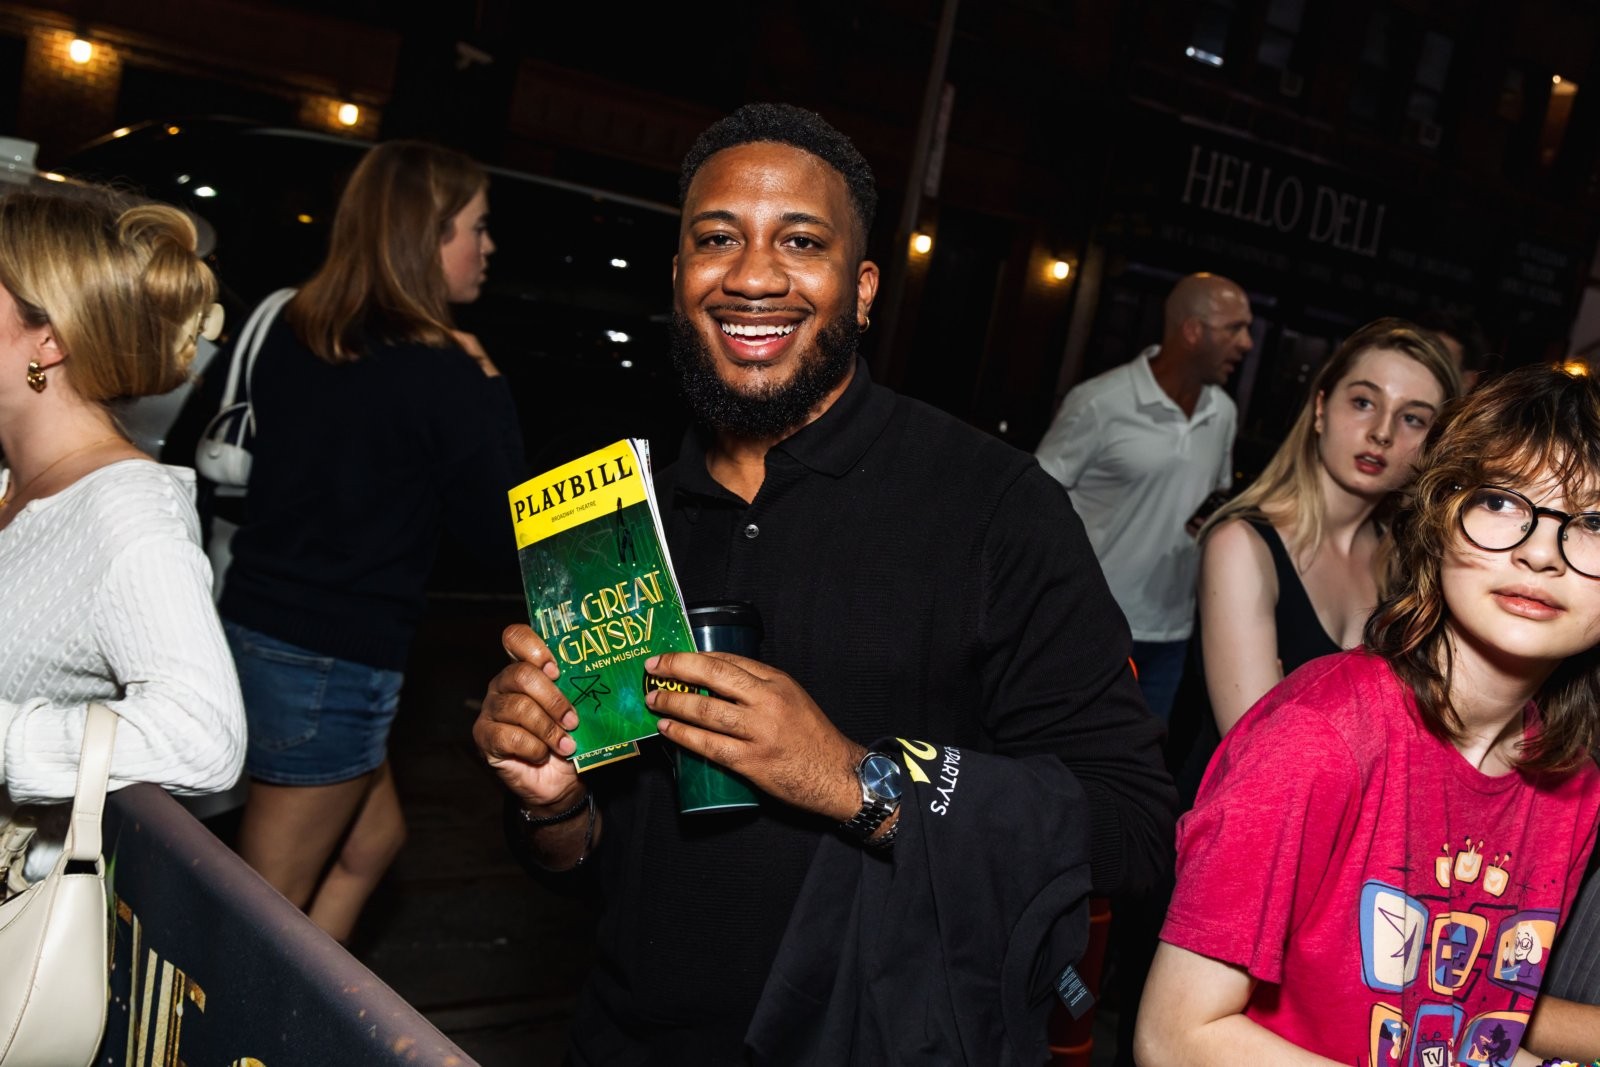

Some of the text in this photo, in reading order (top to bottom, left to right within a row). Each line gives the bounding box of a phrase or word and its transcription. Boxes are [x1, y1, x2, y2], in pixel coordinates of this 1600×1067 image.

[1181, 144, 1304, 232] HELLO
[1308, 184, 1386, 258] DELI
[514, 456, 633, 523] PLAYBILL
[551, 500, 597, 523] BROADWAY THEATRE
[540, 570, 664, 640] THE GREAT
[558, 607, 654, 665] GATSBY
[585, 645, 652, 673] A NEW MUSICAL
[1423, 1048, 1442, 1066] TV
